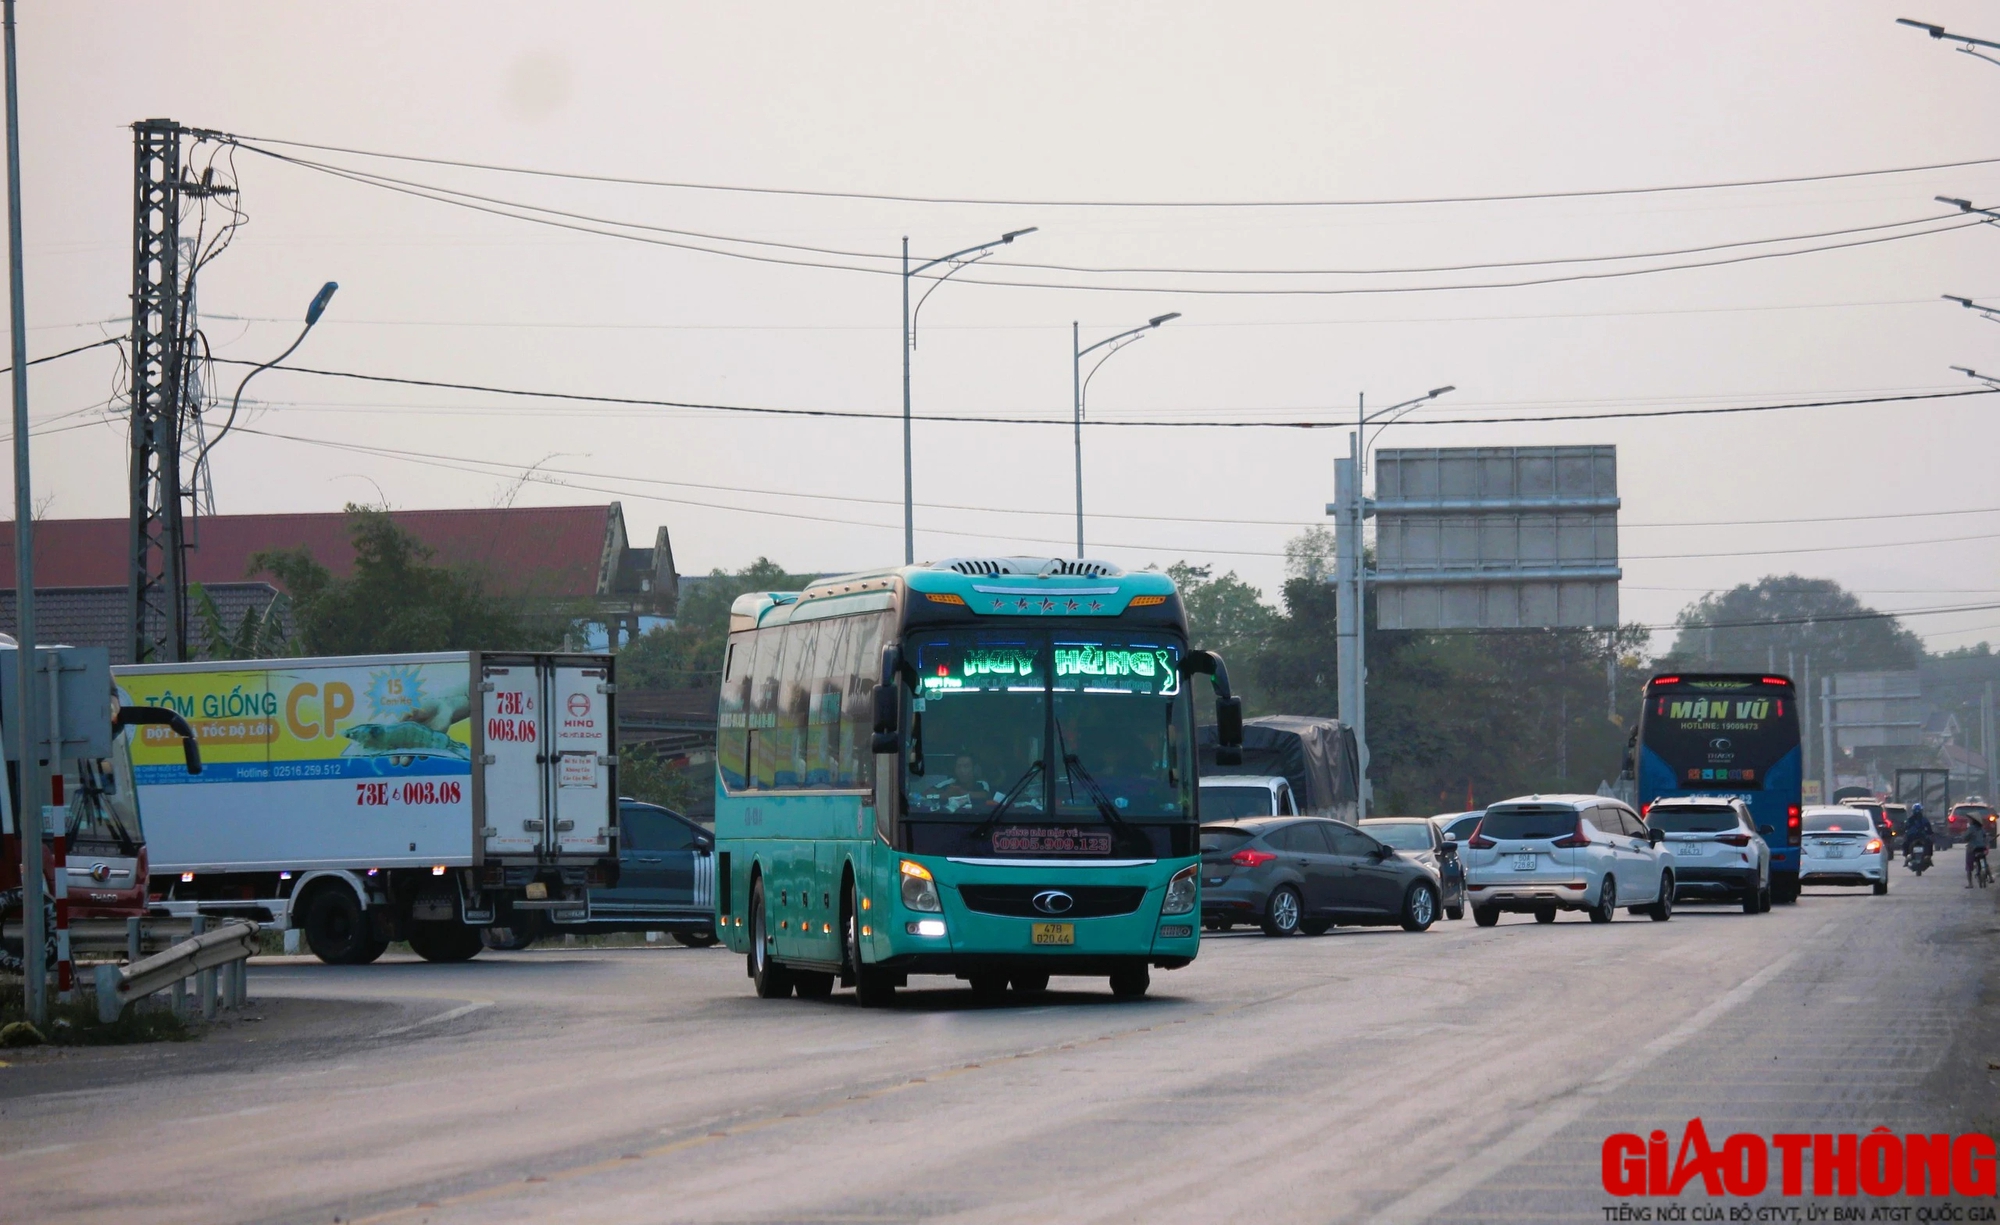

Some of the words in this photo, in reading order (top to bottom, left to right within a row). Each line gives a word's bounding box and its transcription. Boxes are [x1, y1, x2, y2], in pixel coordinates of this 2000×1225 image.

[203, 685, 277, 718] GIỐNG
[286, 682, 355, 740] CP
[497, 692, 523, 715] 73E
[1670, 698, 1729, 721] MẬN
[1736, 698, 1769, 719] VŨ
[488, 718, 536, 742] 003.08
[356, 783, 389, 806] 73E
[403, 782, 461, 804] 003.08
[1000, 838, 1108, 850] 0905.909.123
[1037, 934, 1069, 943] 020.44
[1044, 924, 1062, 933] 47B
